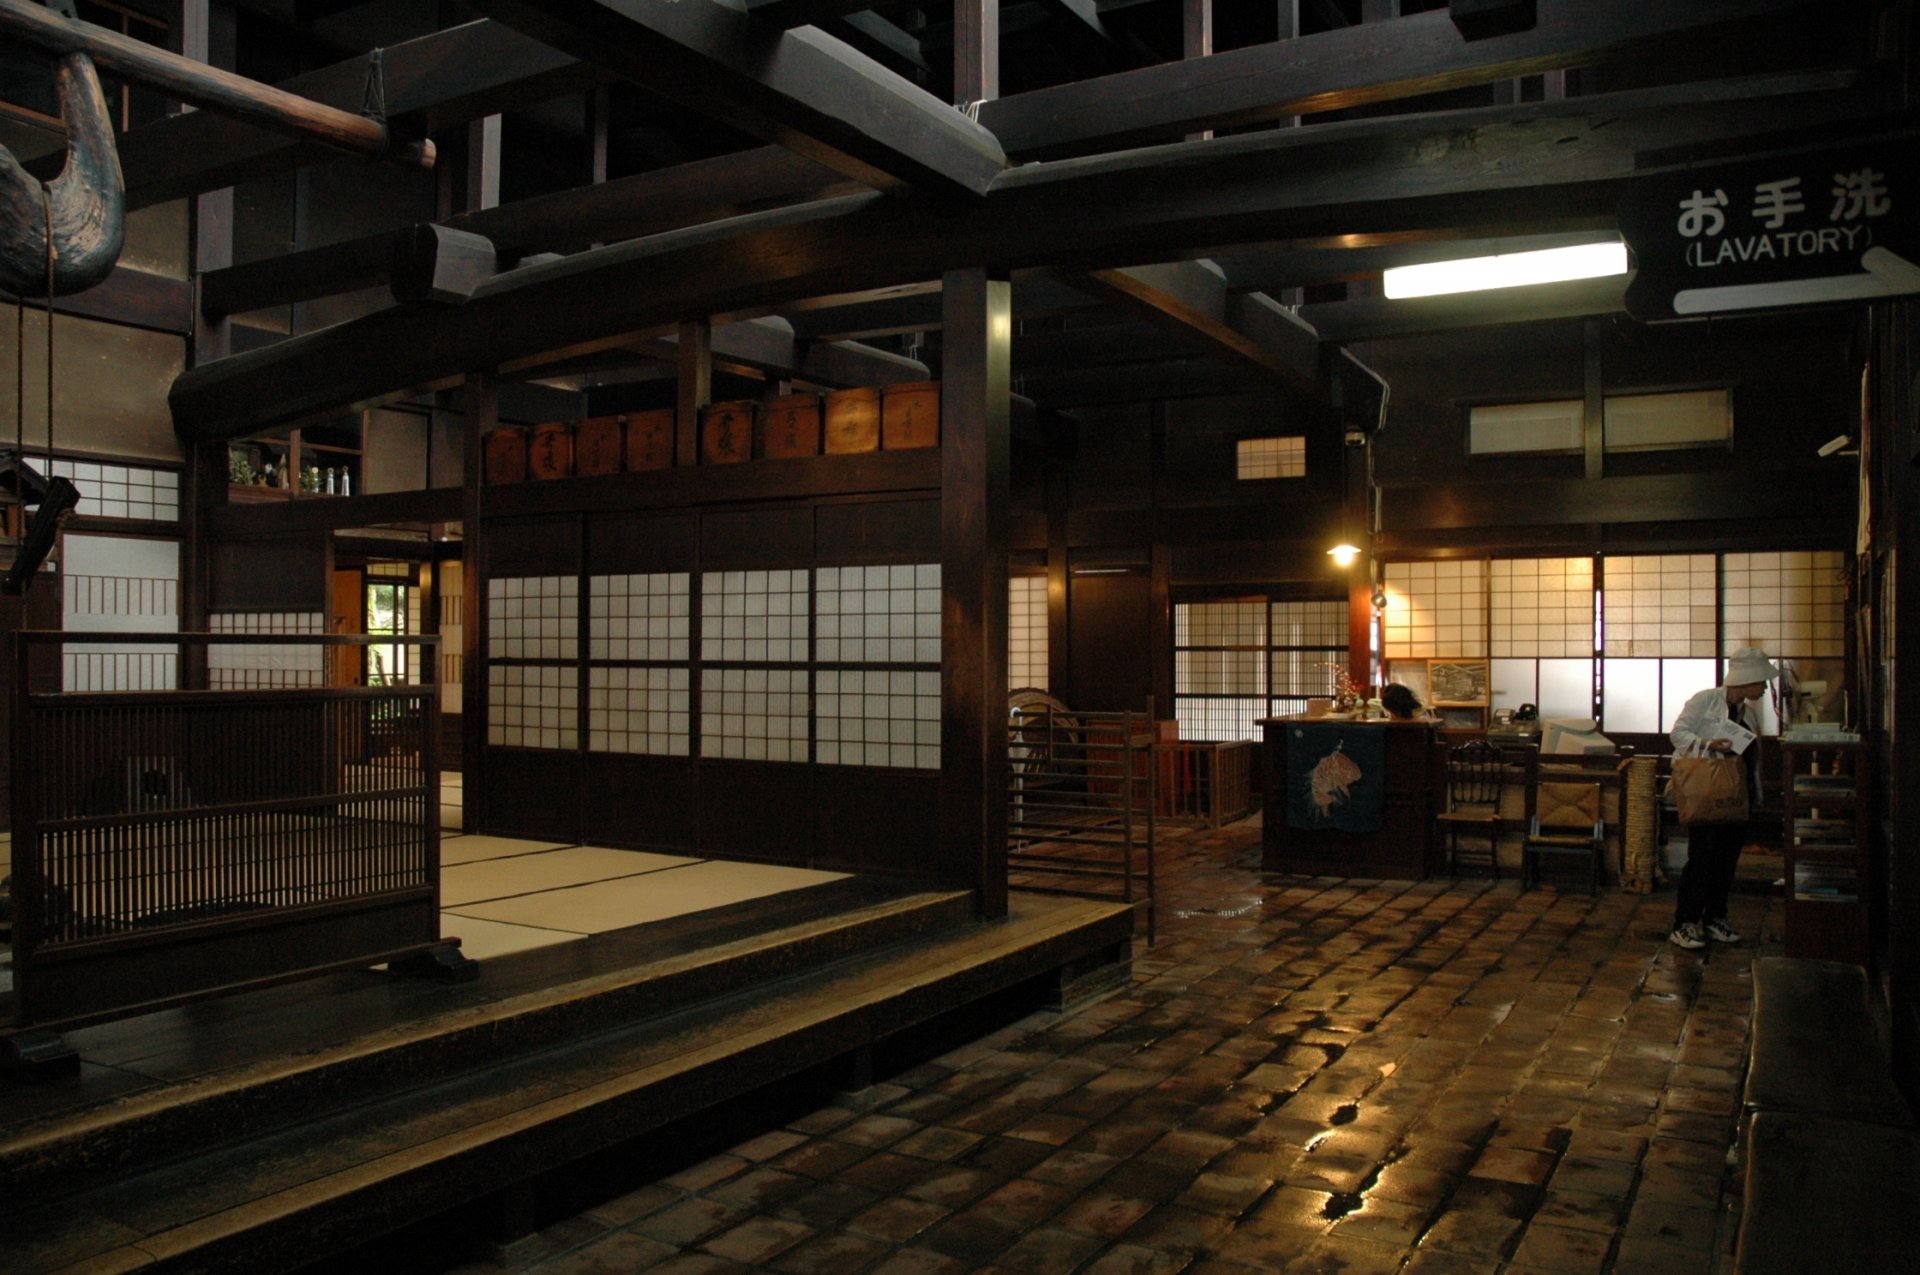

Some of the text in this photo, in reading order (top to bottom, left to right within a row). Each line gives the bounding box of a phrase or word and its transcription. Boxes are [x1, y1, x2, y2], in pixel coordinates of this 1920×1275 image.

[1677, 167, 1893, 238] お手洗
[1685, 225, 1873, 268] (LAVATORY)
